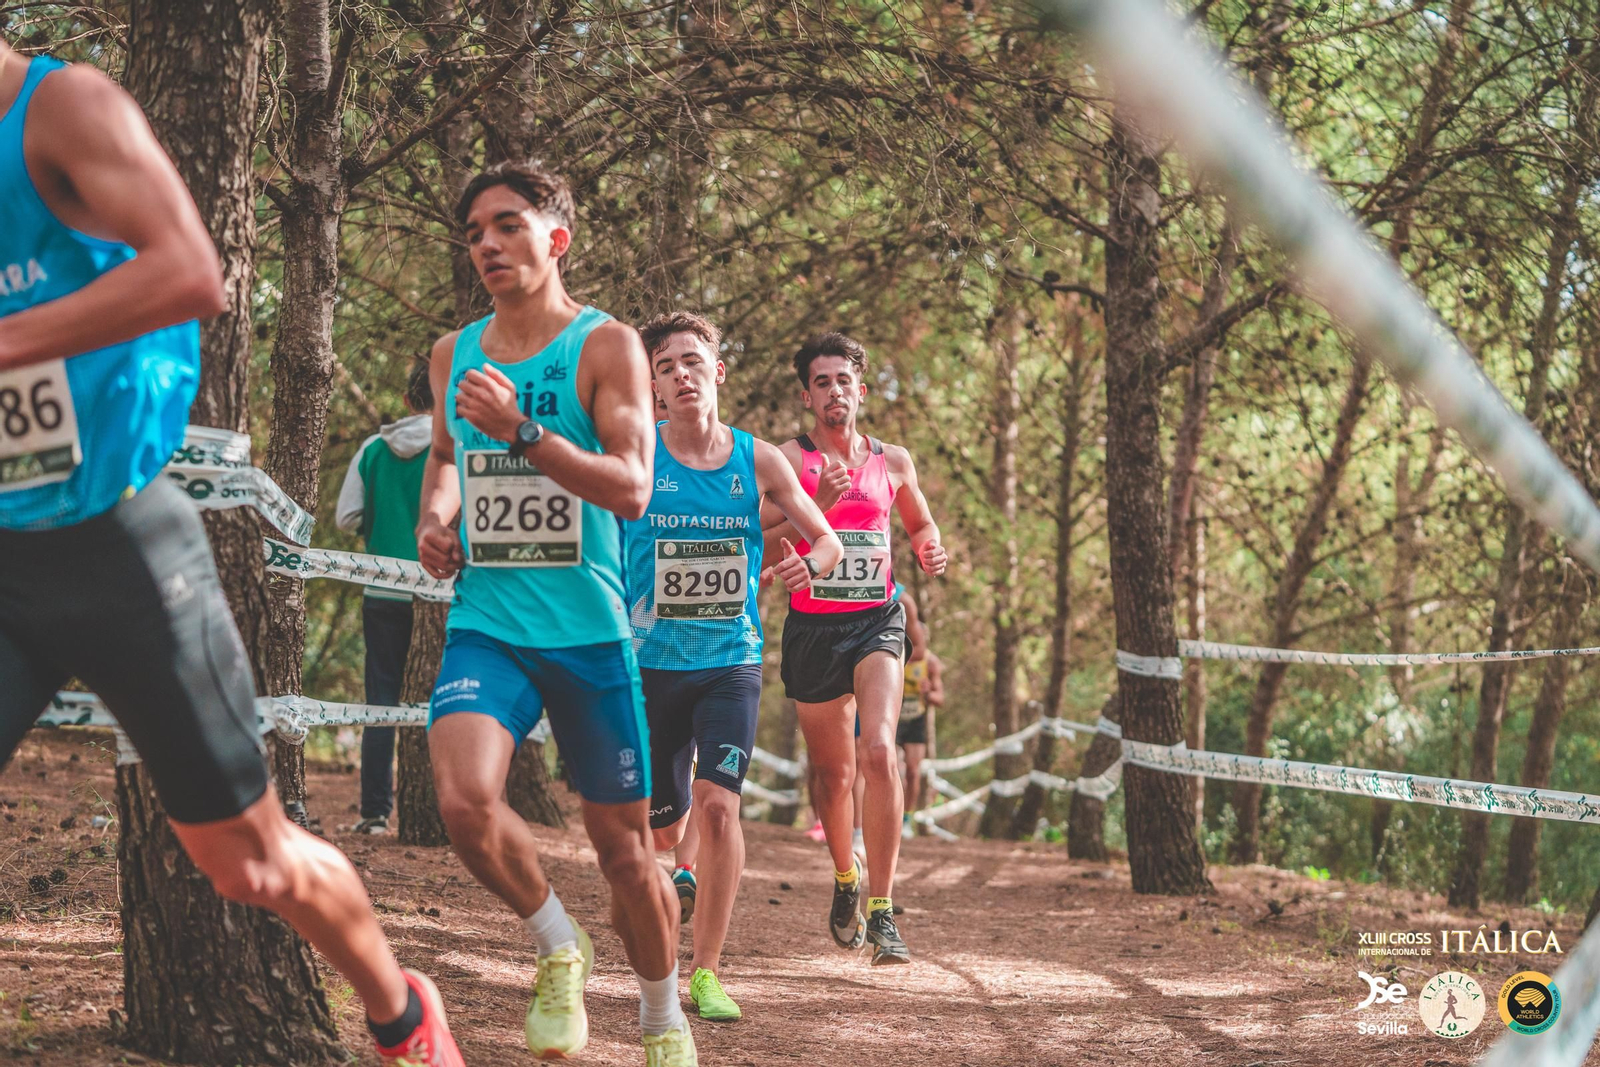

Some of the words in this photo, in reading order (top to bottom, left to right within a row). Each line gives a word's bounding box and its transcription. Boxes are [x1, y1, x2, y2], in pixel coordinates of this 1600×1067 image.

[0, 379, 63, 437] 86
[841, 491, 869, 502] SARICHE
[475, 495, 571, 532] 8268
[648, 513, 750, 530] TROTASIERRA
[839, 532, 870, 542] TÁLICA
[682, 542, 725, 554] ITÁLICA
[663, 568, 742, 597] 8290
